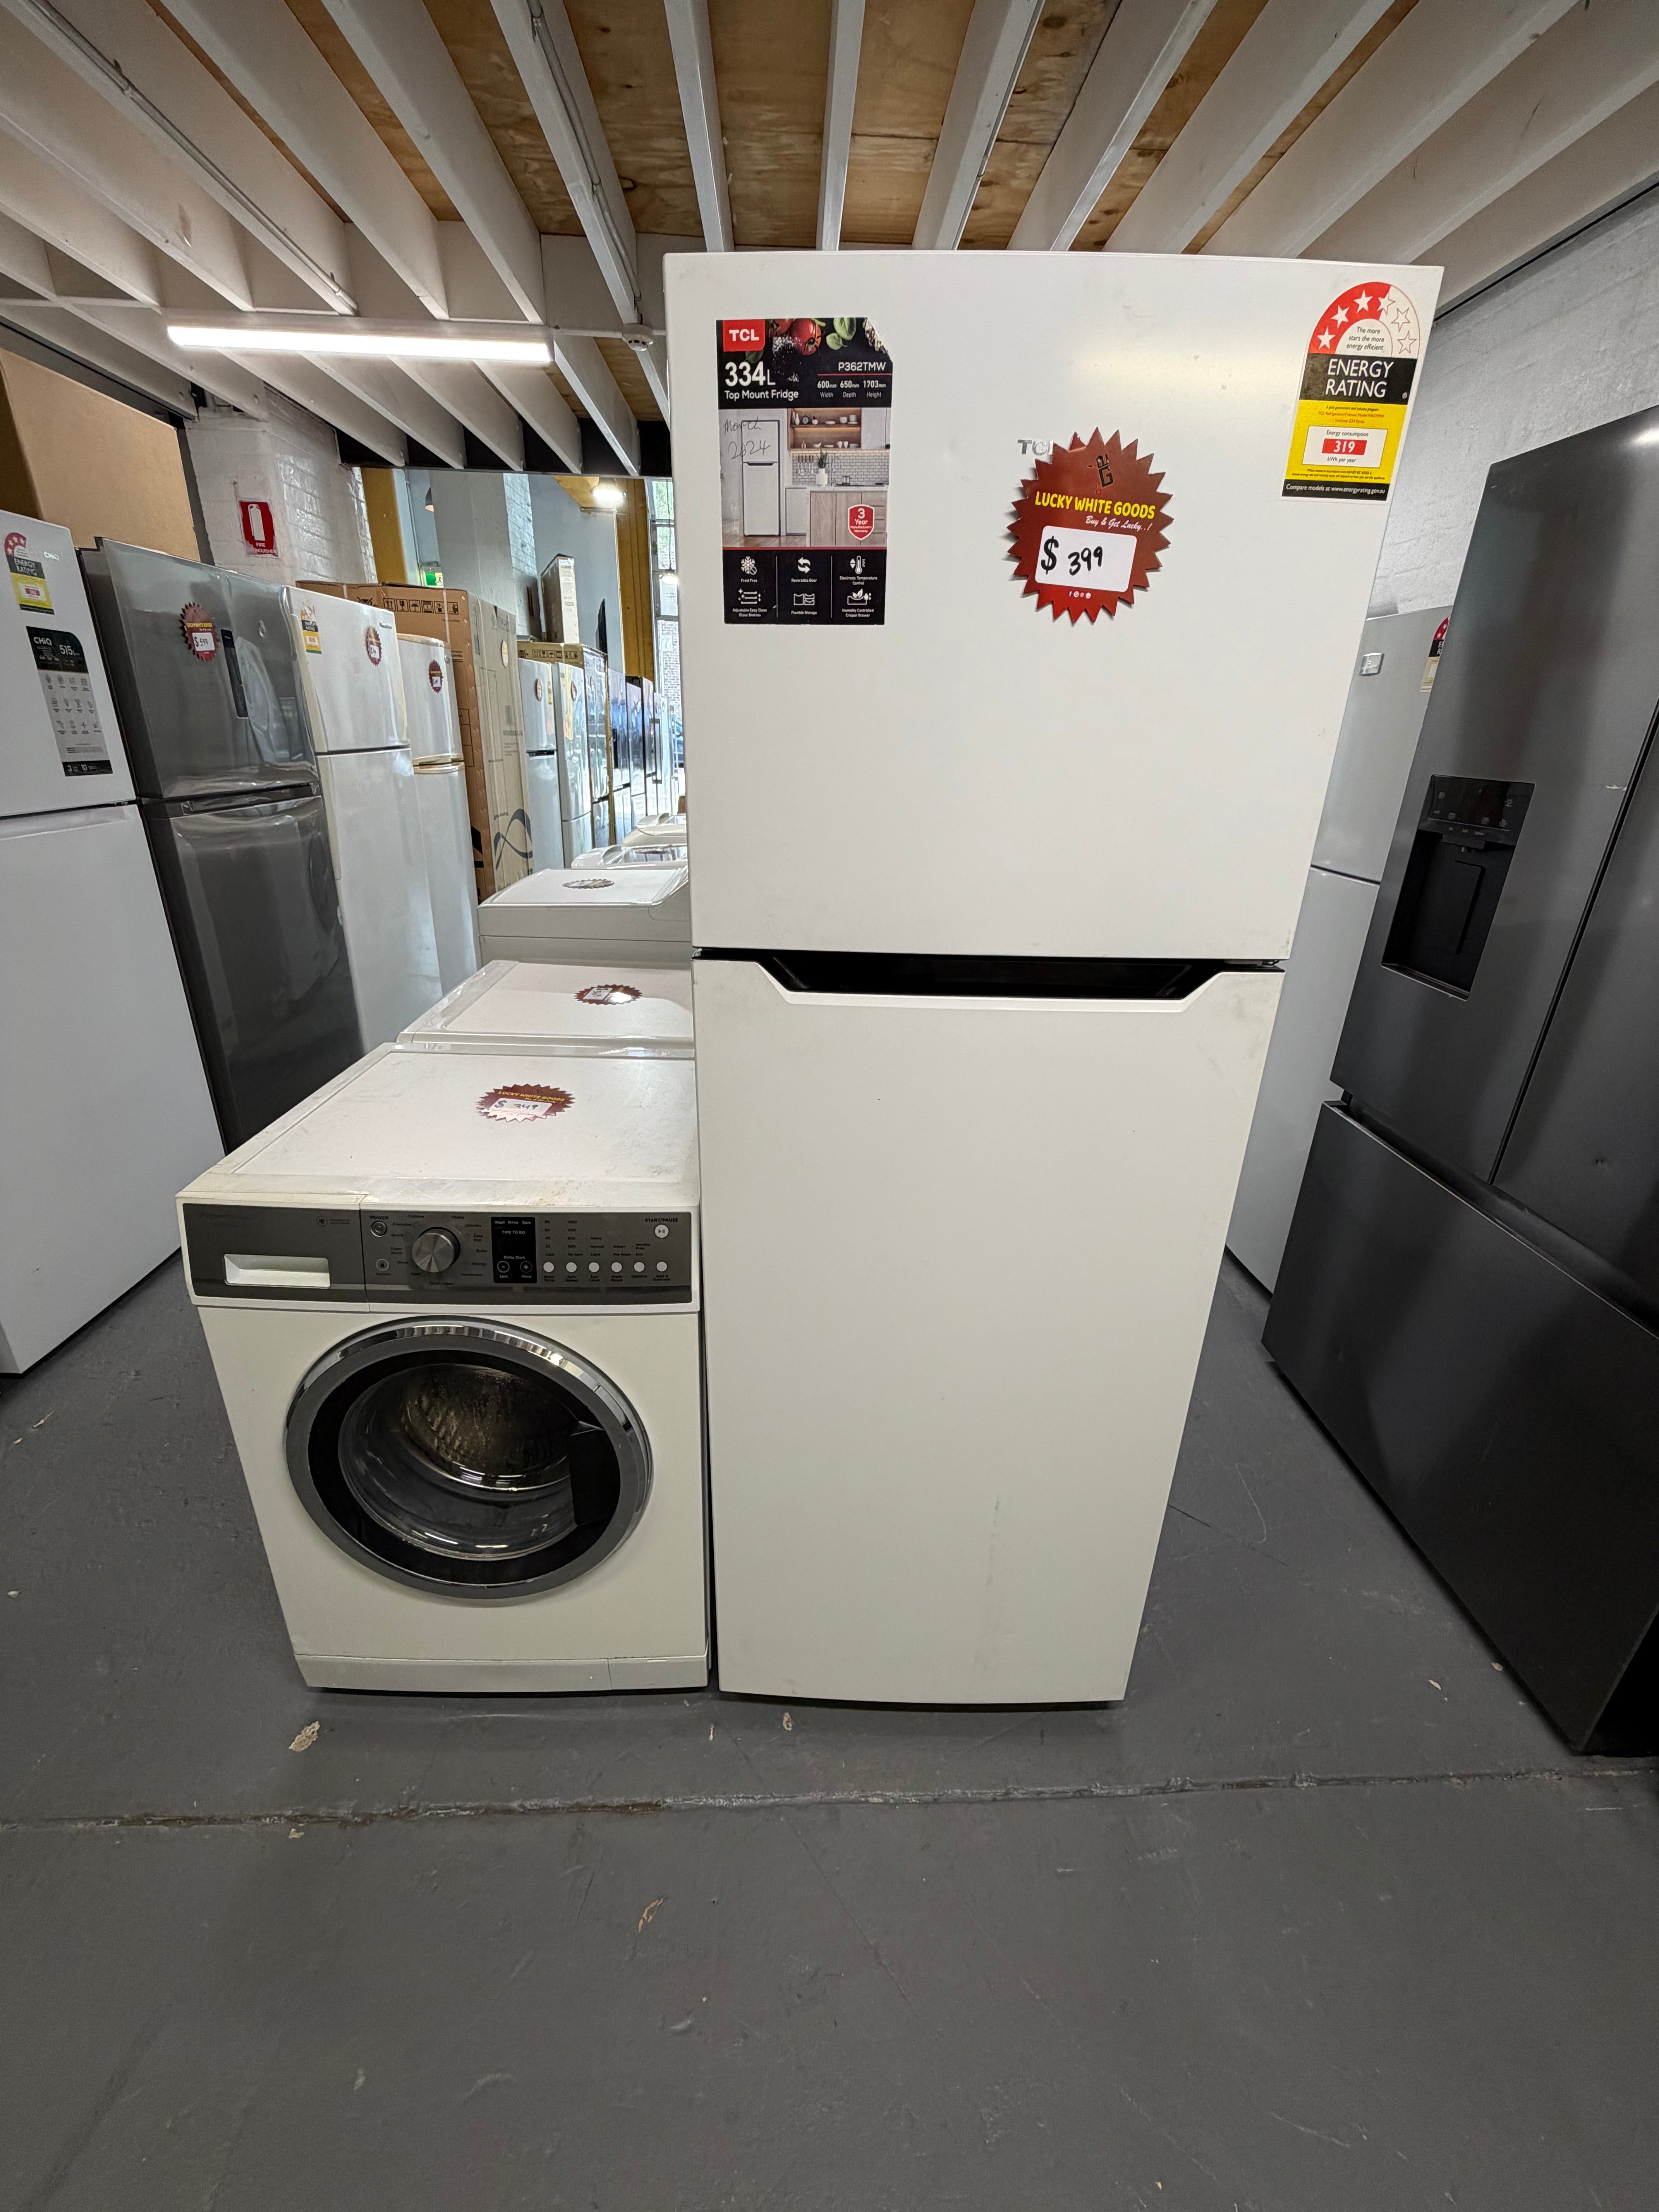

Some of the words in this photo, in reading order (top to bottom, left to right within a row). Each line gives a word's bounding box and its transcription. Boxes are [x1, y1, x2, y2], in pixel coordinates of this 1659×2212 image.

[729, 329, 759, 342] TCL
[1364, 343, 1384, 351] efficient
[838, 361, 886, 371] P362TMW
[1327, 358, 1395, 379] ENERGY
[817, 380, 837, 388] 600mm
[840, 380, 860, 388] 650mm
[863, 380, 886, 388] 1703mm
[1325, 378, 1388, 398] RATING
[725, 390, 740, 402] Top
[742, 390, 769, 399] Mount
[771, 389, 799, 402] Fridge
[728, 440, 771, 460] 2024
[1333, 440, 1356, 453] 319
[1035, 491, 1073, 510] LUCKY
[1074, 496, 1113, 514] WHITE
[1113, 501, 1156, 519] GOODS
[857, 508, 866, 519] 3
[1085, 515, 1099, 527] Buy
[1101, 517, 1108, 526] &
[1108, 518, 1120, 529] Get
[1041, 536, 1059, 575] $
[1068, 546, 1103, 576] 399
[33, 636, 53, 646] CHiQ
[494, 1100, 507, 1108] $
